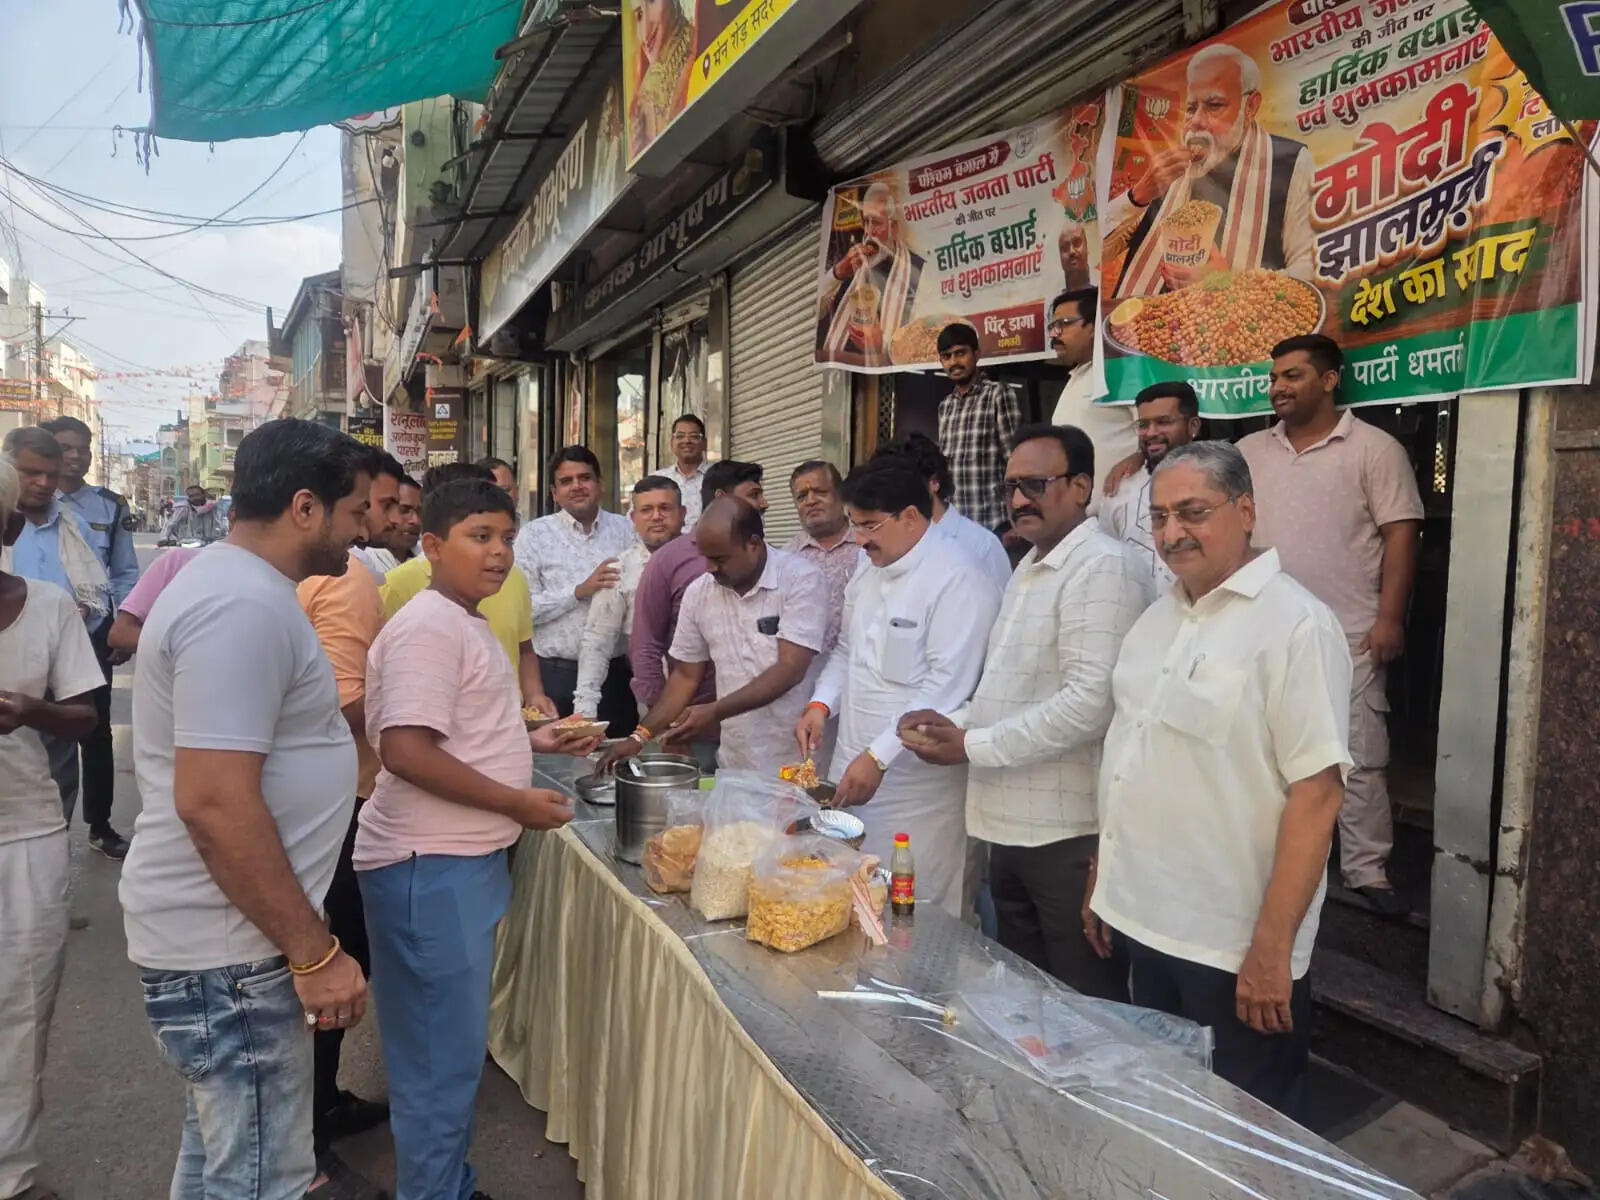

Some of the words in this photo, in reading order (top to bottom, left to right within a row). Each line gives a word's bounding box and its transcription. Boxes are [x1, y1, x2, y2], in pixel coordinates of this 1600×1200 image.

[1270, 5, 1364, 62] भारतीय
[1351, 30, 1372, 50] की
[1377, 15, 1407, 39] जीत
[1413, 3, 1434, 22] पर
[1299, 43, 1393, 106] हार्दिक
[1297, 100, 1328, 132] एवं
[917, 166, 952, 189] पश्चिम
[1314, 82, 1478, 220] मोदी
[903, 188, 958, 223] भारतीय
[960, 172, 1011, 207] जनता
[1013, 151, 1057, 190] पार्टी
[639, 167, 730, 271] आभूषण
[934, 229, 986, 272] हार्दिक
[987, 208, 1038, 254] बधाई
[955, 212, 966, 226] की
[967, 209, 984, 223] जीत
[985, 207, 997, 218] पर
[941, 275, 956, 295] एवं
[1350, 278, 1397, 326] देश
[1400, 257, 1446, 304] का
[1452, 227, 1537, 291] स्वाद
[1352, 344, 1400, 385] पार्टी
